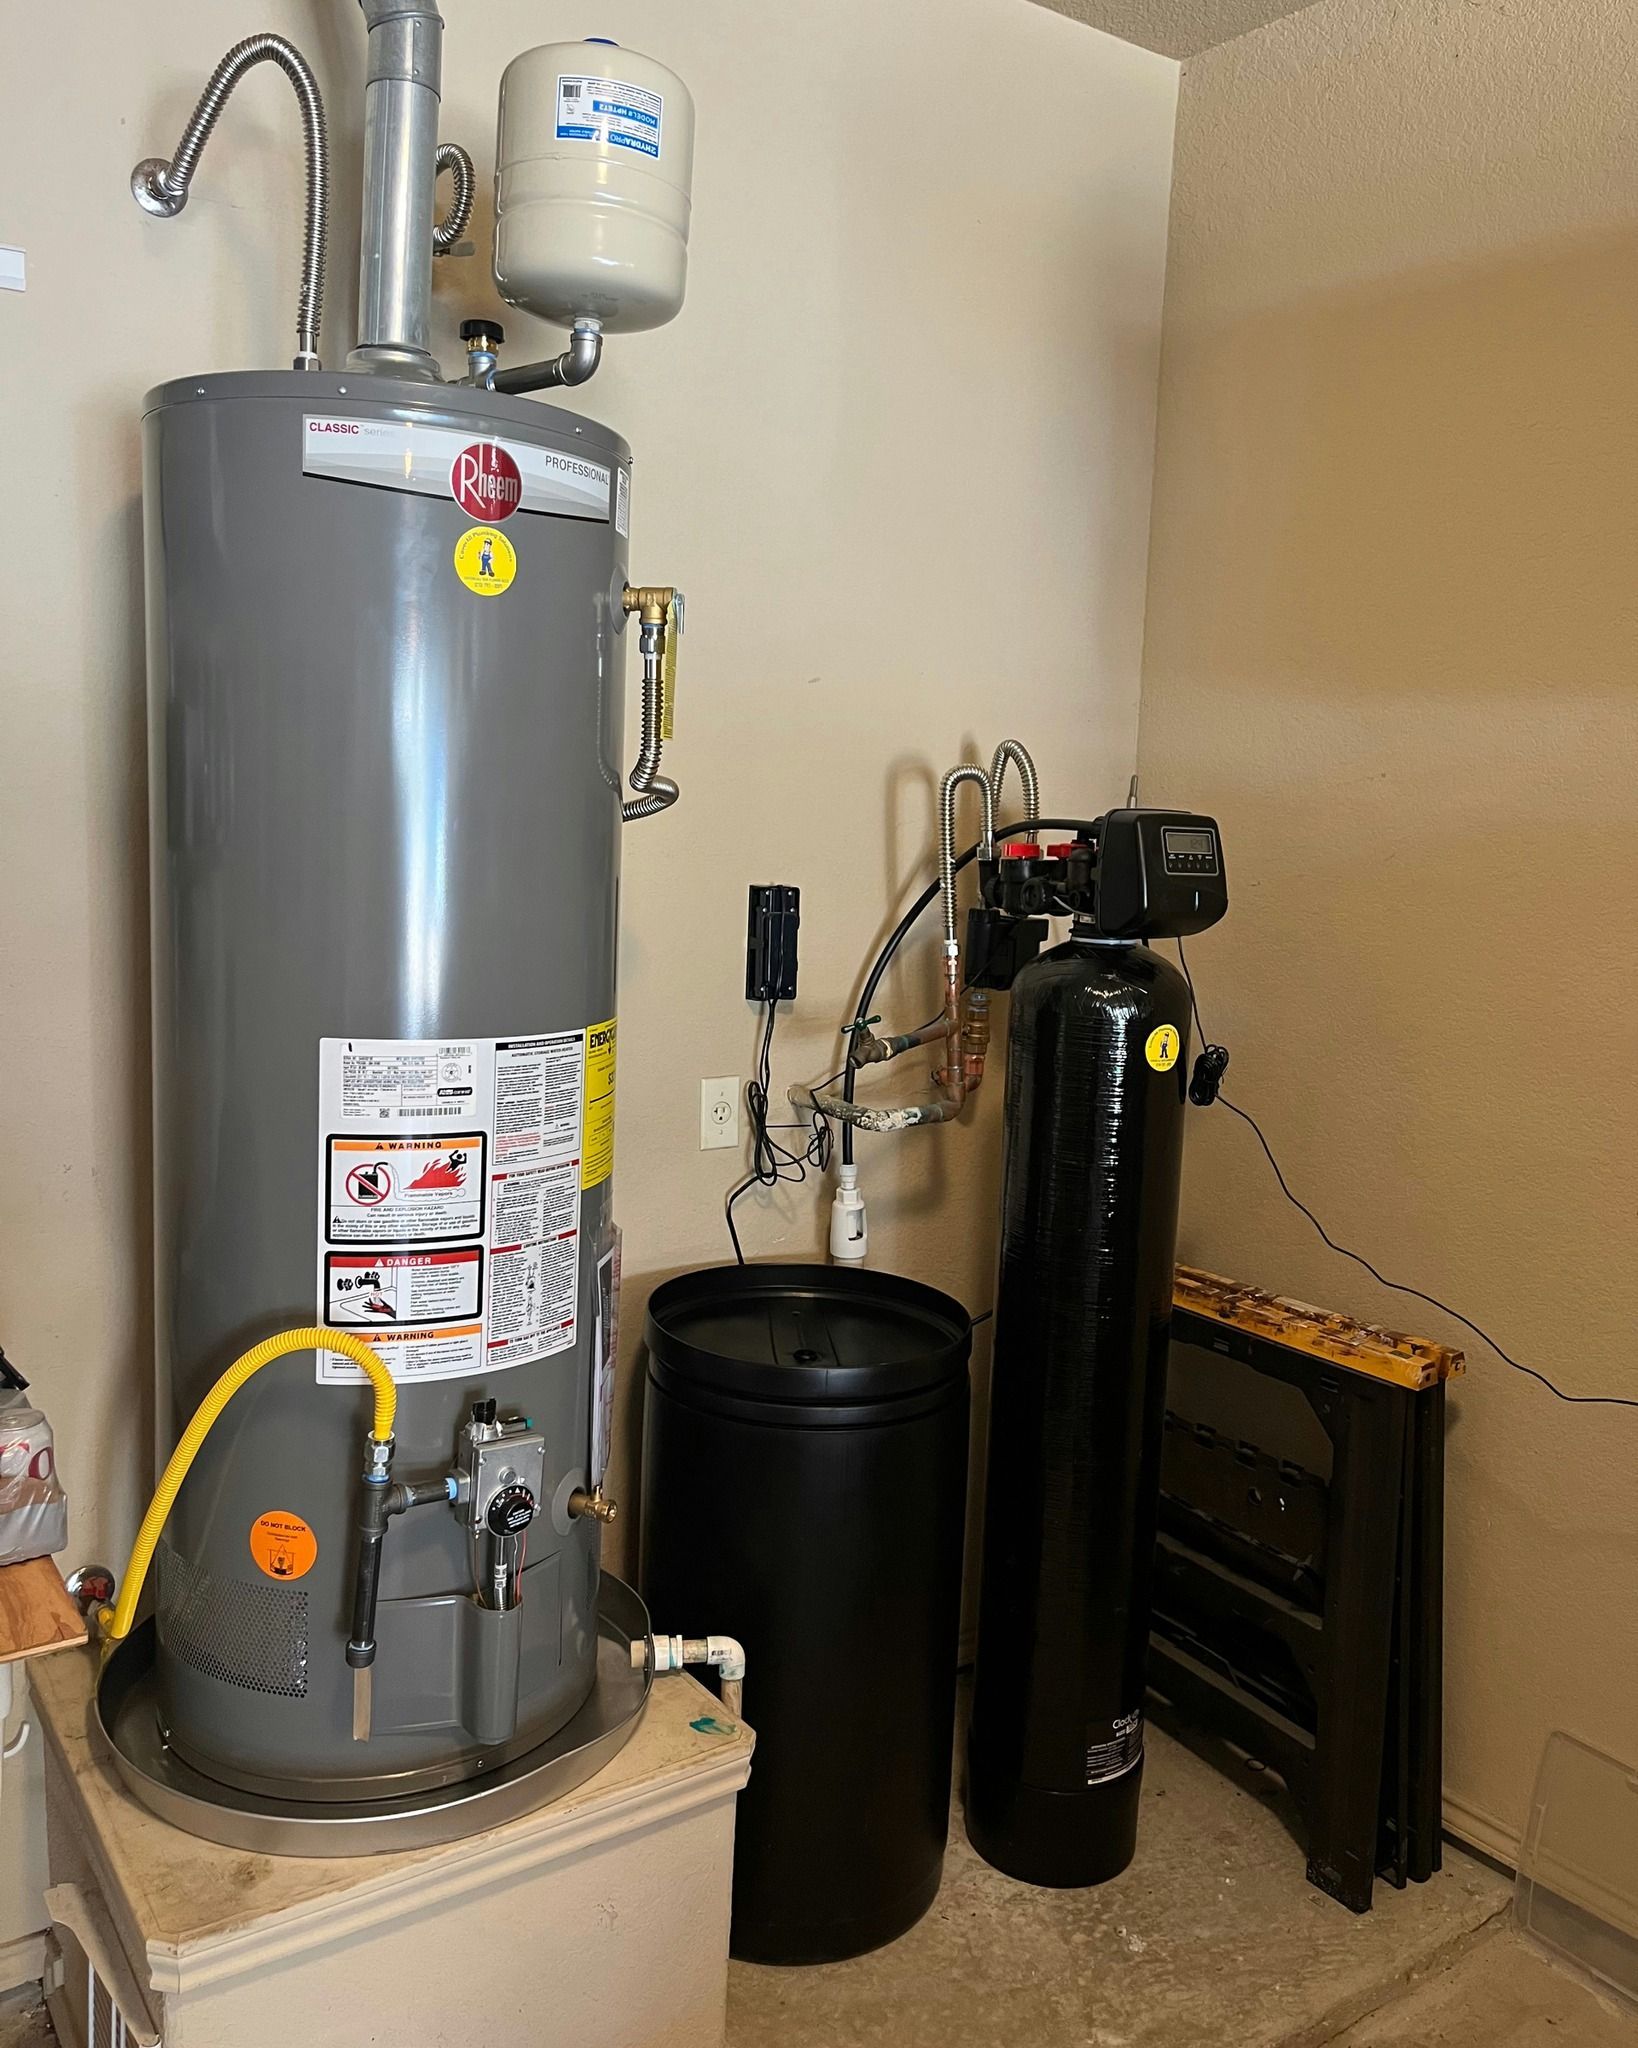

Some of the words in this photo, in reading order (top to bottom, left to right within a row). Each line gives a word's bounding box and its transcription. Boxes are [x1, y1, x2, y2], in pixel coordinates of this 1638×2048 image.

[309, 422, 360, 434] CLASSIC
[545, 455, 609, 486] PROFESSIONAL
[459, 443, 518, 509] Rheem
[388, 1141, 442, 1150] WARNING
[386, 1257, 431, 1266] DANGER
[387, 1331, 434, 1341] WARNING
[284, 1524, 306, 1532] BLOCK
